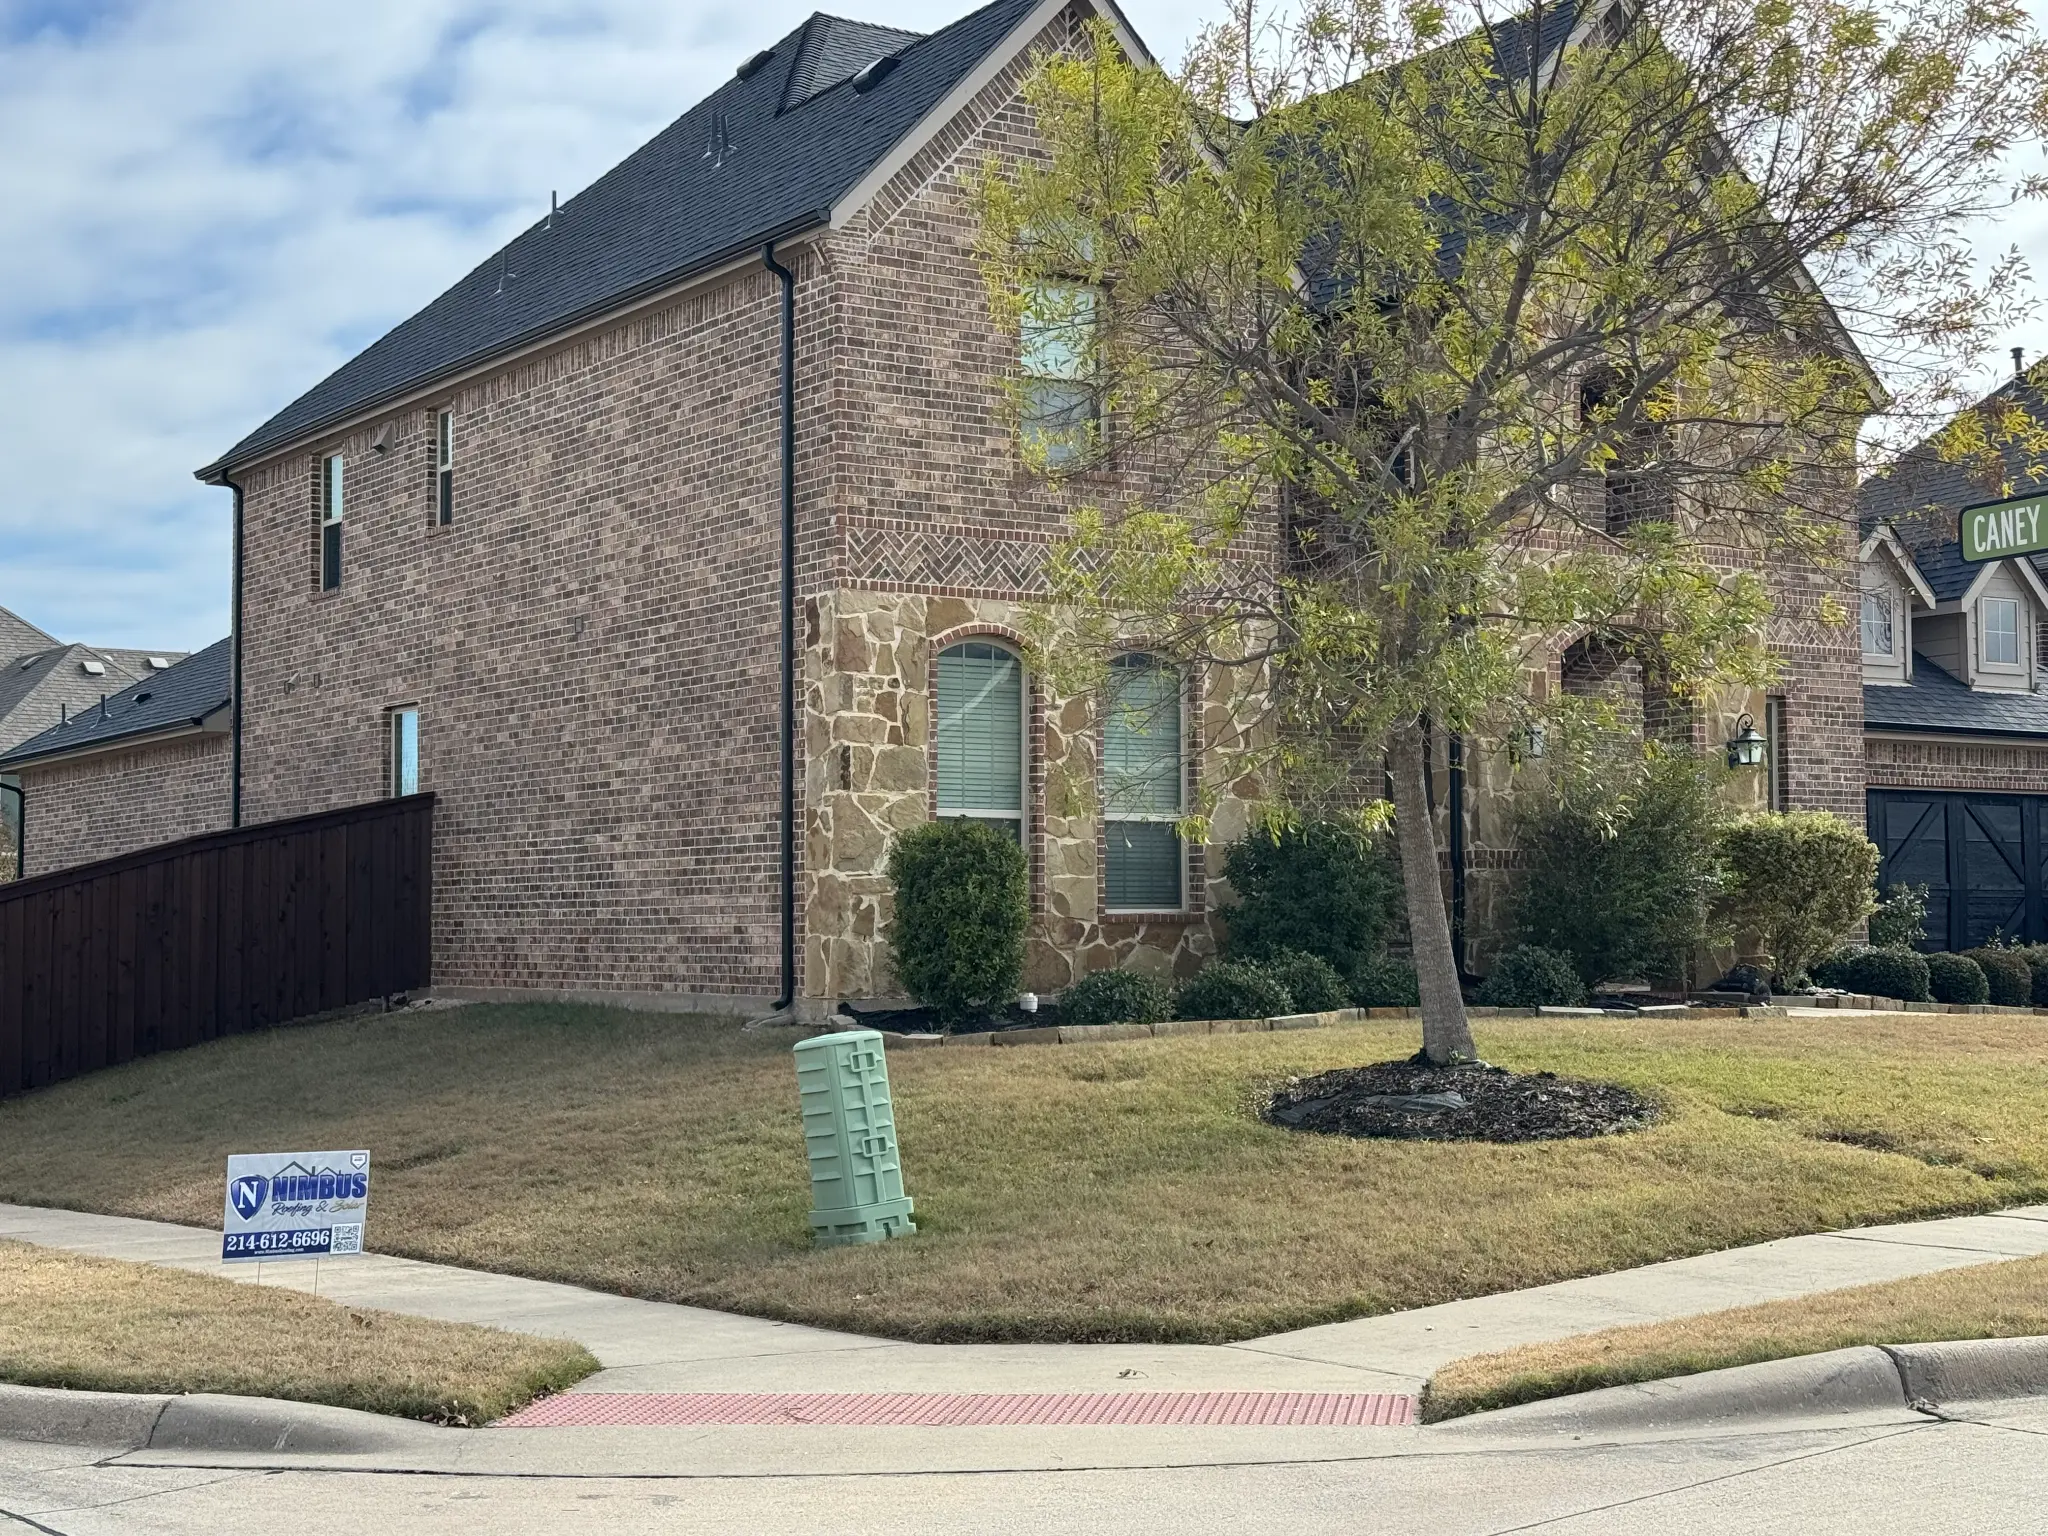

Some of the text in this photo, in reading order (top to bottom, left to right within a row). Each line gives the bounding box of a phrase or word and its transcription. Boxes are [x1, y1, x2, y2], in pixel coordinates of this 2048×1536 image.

[1973, 504, 2041, 553] CANEY
[237, 1181, 259, 1209] N
[271, 1172, 367, 1202] NIMBUS
[271, 1202, 313, 1218] Roofing
[315, 1200, 329, 1213] &
[226, 1230, 330, 1251] 214-612-6696
